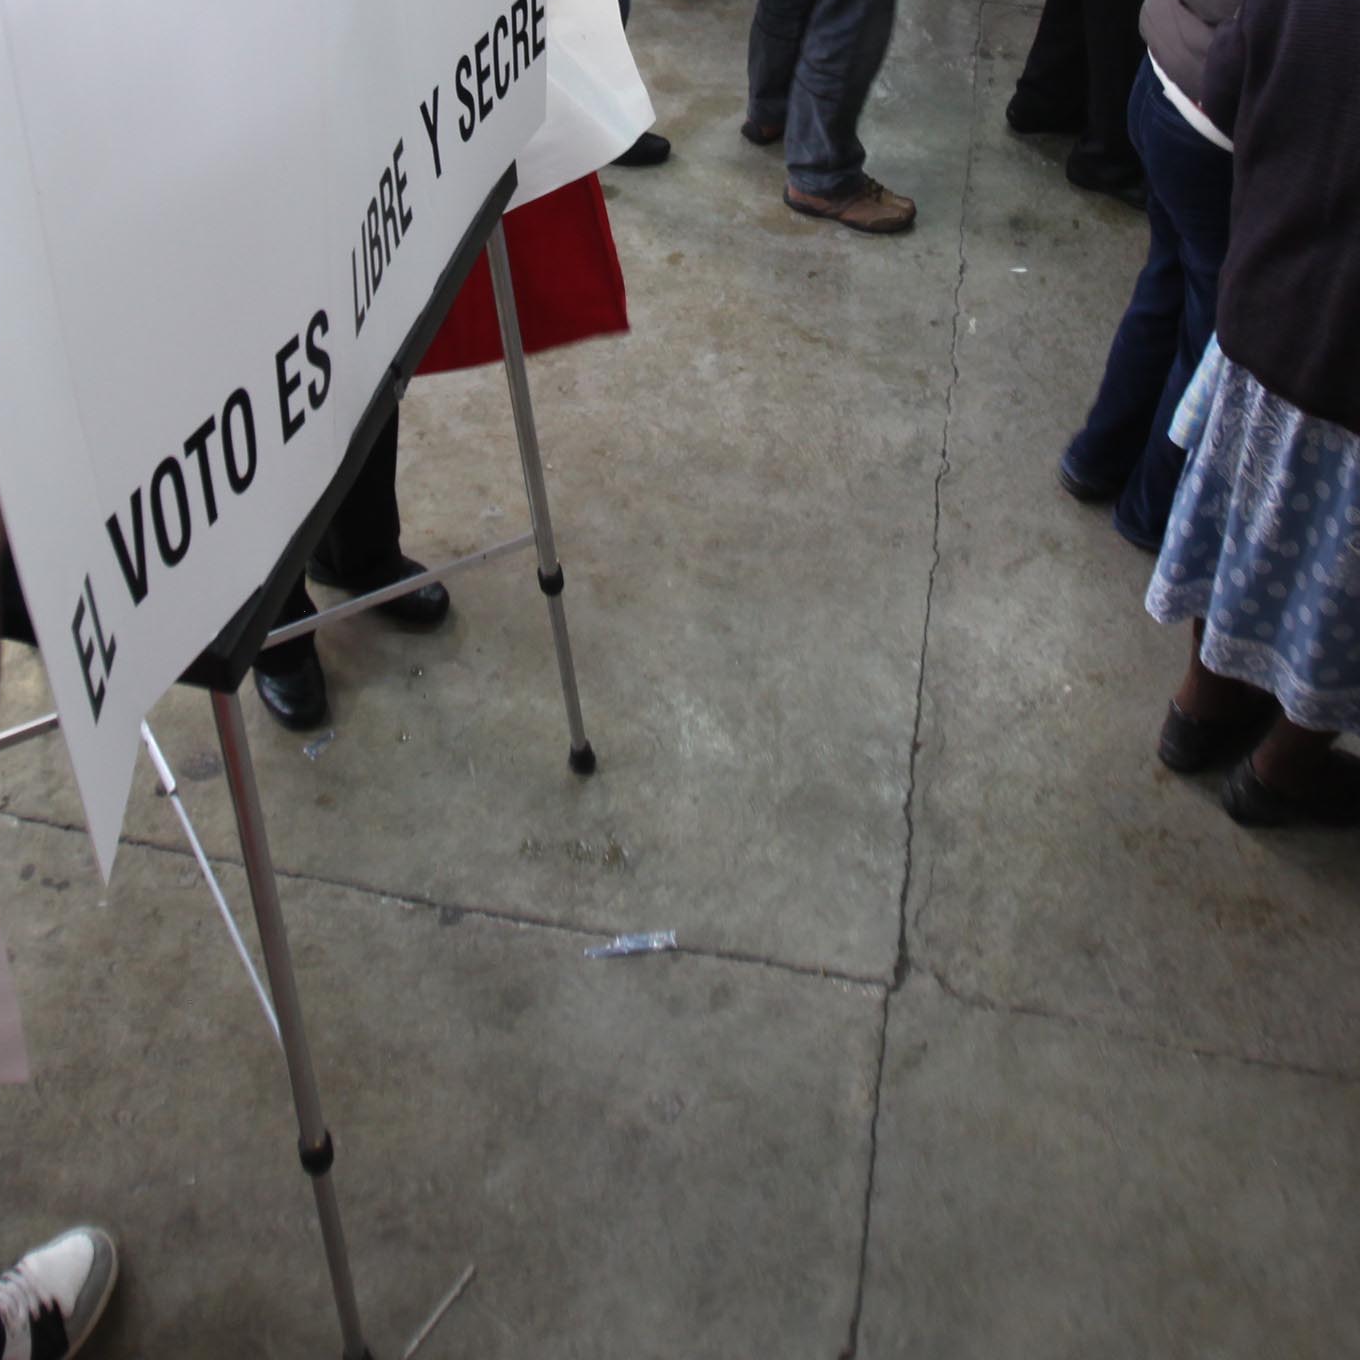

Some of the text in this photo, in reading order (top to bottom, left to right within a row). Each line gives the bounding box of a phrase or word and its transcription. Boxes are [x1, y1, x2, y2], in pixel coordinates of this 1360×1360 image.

[70, 573, 117, 724] EL
[105, 387, 258, 607] VOTO
[274, 309, 332, 444] ES
[351, 138, 413, 339] LIBRE
[420, 86, 443, 180] Y
